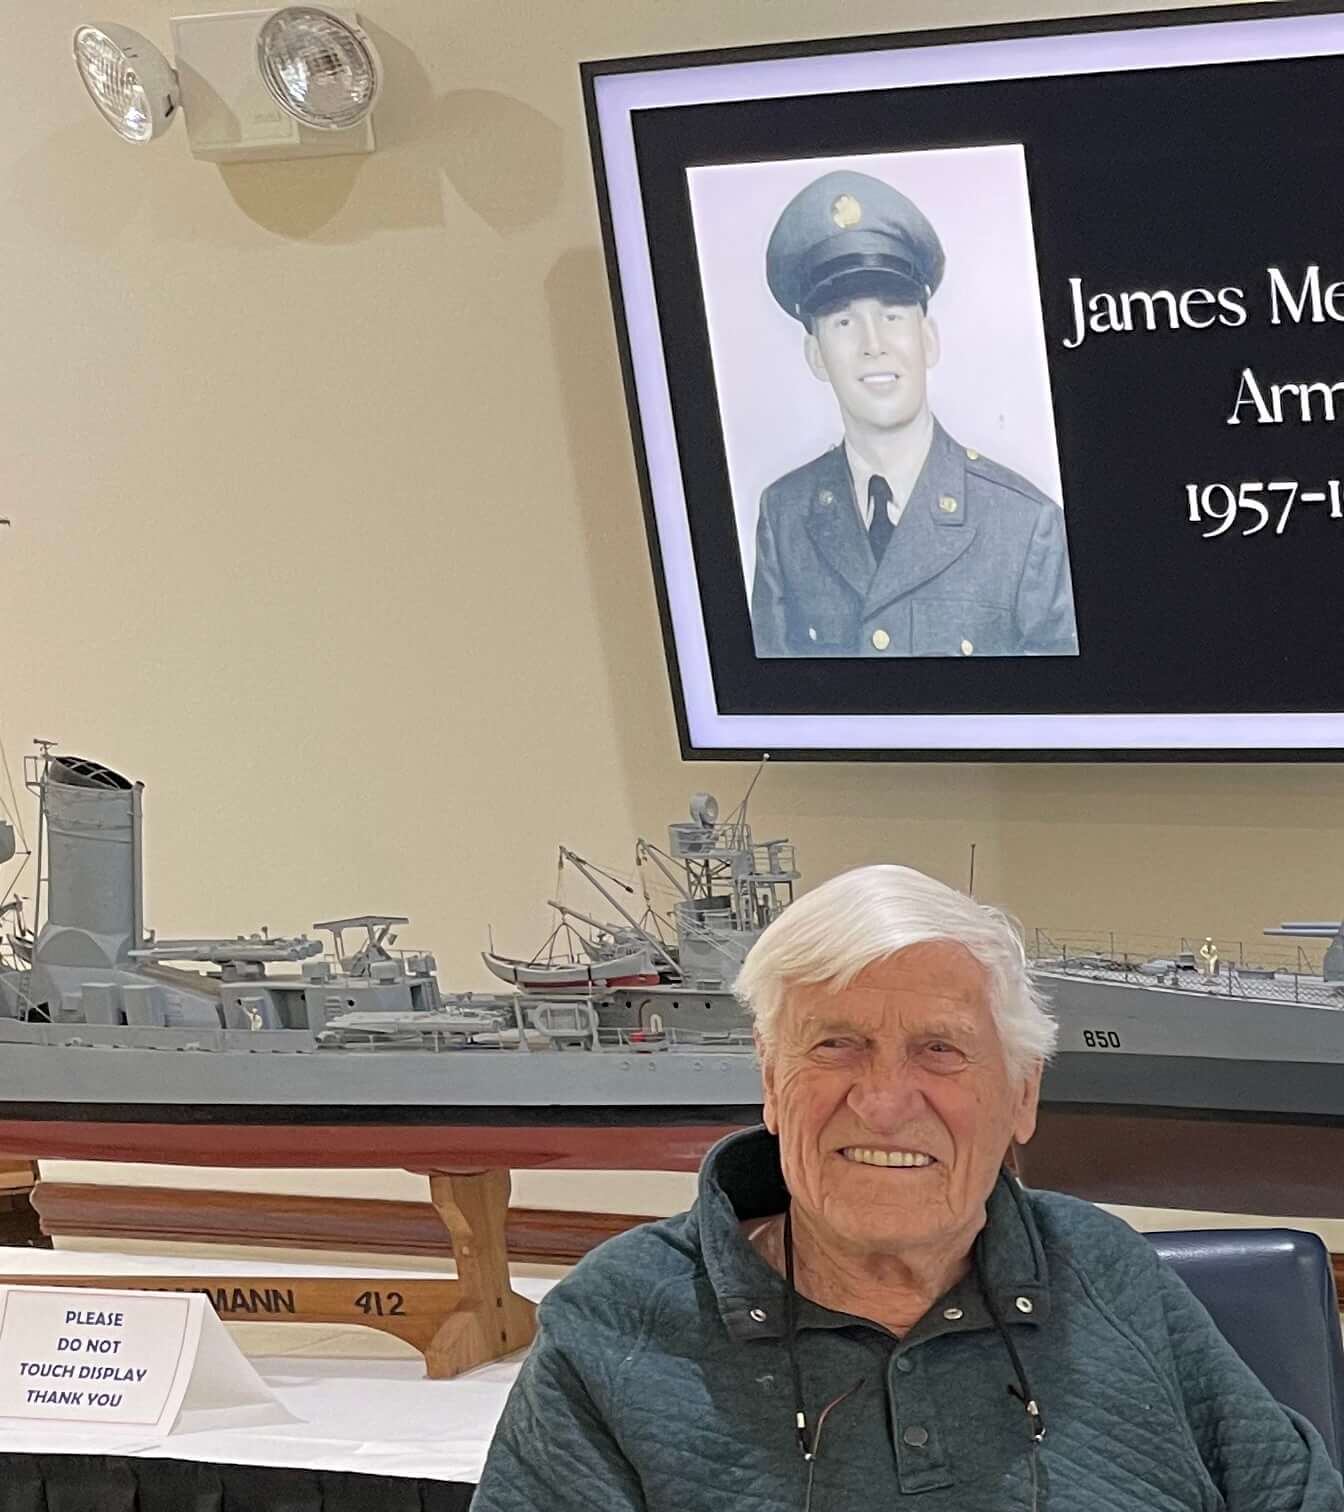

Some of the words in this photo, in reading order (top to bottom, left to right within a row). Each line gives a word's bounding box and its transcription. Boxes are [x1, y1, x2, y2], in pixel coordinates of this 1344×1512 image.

[1063, 277, 1247, 348] James
[1083, 1030, 1121, 1048] 850
[354, 1291, 407, 1316] 412
[65, 1310, 124, 1327] PLEASE
[57, 1337, 81, 1352] DO
[86, 1339, 122, 1354] NOT
[20, 1362, 76, 1379] TOUCH
[78, 1365, 148, 1382] DISPLAY
[26, 1389, 84, 1405] THANK
[87, 1391, 123, 1407] YOU
